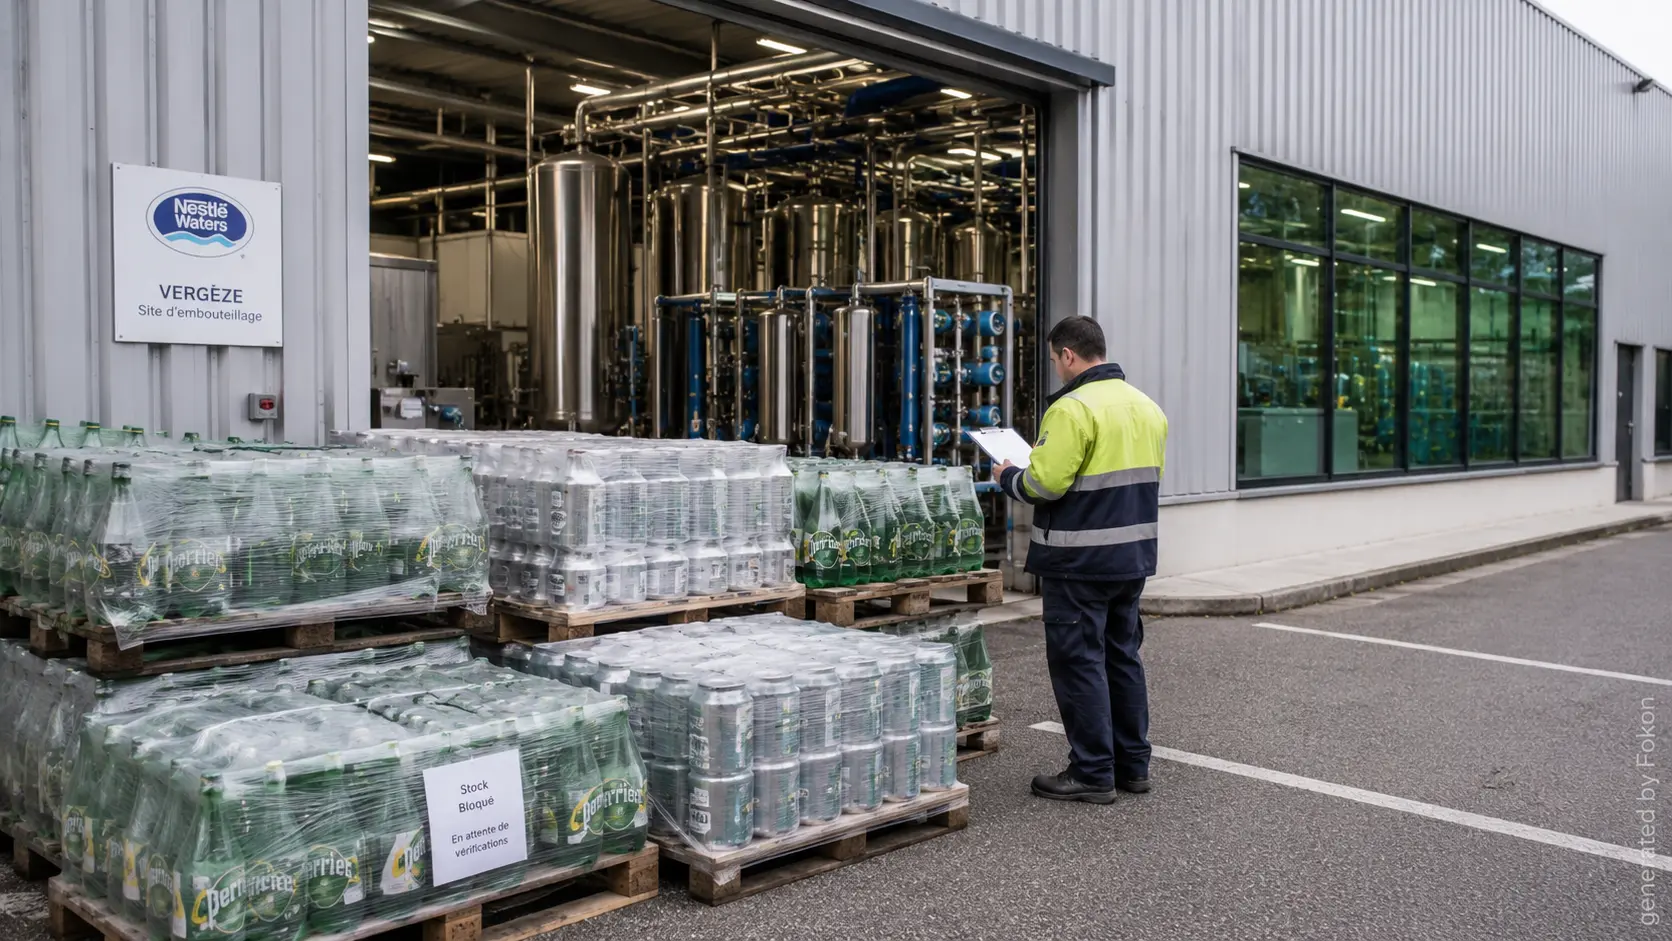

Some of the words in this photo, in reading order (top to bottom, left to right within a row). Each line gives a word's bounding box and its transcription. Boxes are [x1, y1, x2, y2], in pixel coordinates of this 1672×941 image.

[175, 213, 228, 232] Waters
[159, 284, 243, 304] VERGÈZE
[138, 304, 163, 317] Site
[166, 306, 263, 324] d'embouteillage
[460, 780, 489, 795] Stock
[458, 796, 495, 813] Bloqué
[451, 834, 464, 844] En
[465, 826, 497, 840] attente
[498, 822, 509, 831] de
[455, 837, 509, 858] vérifications
